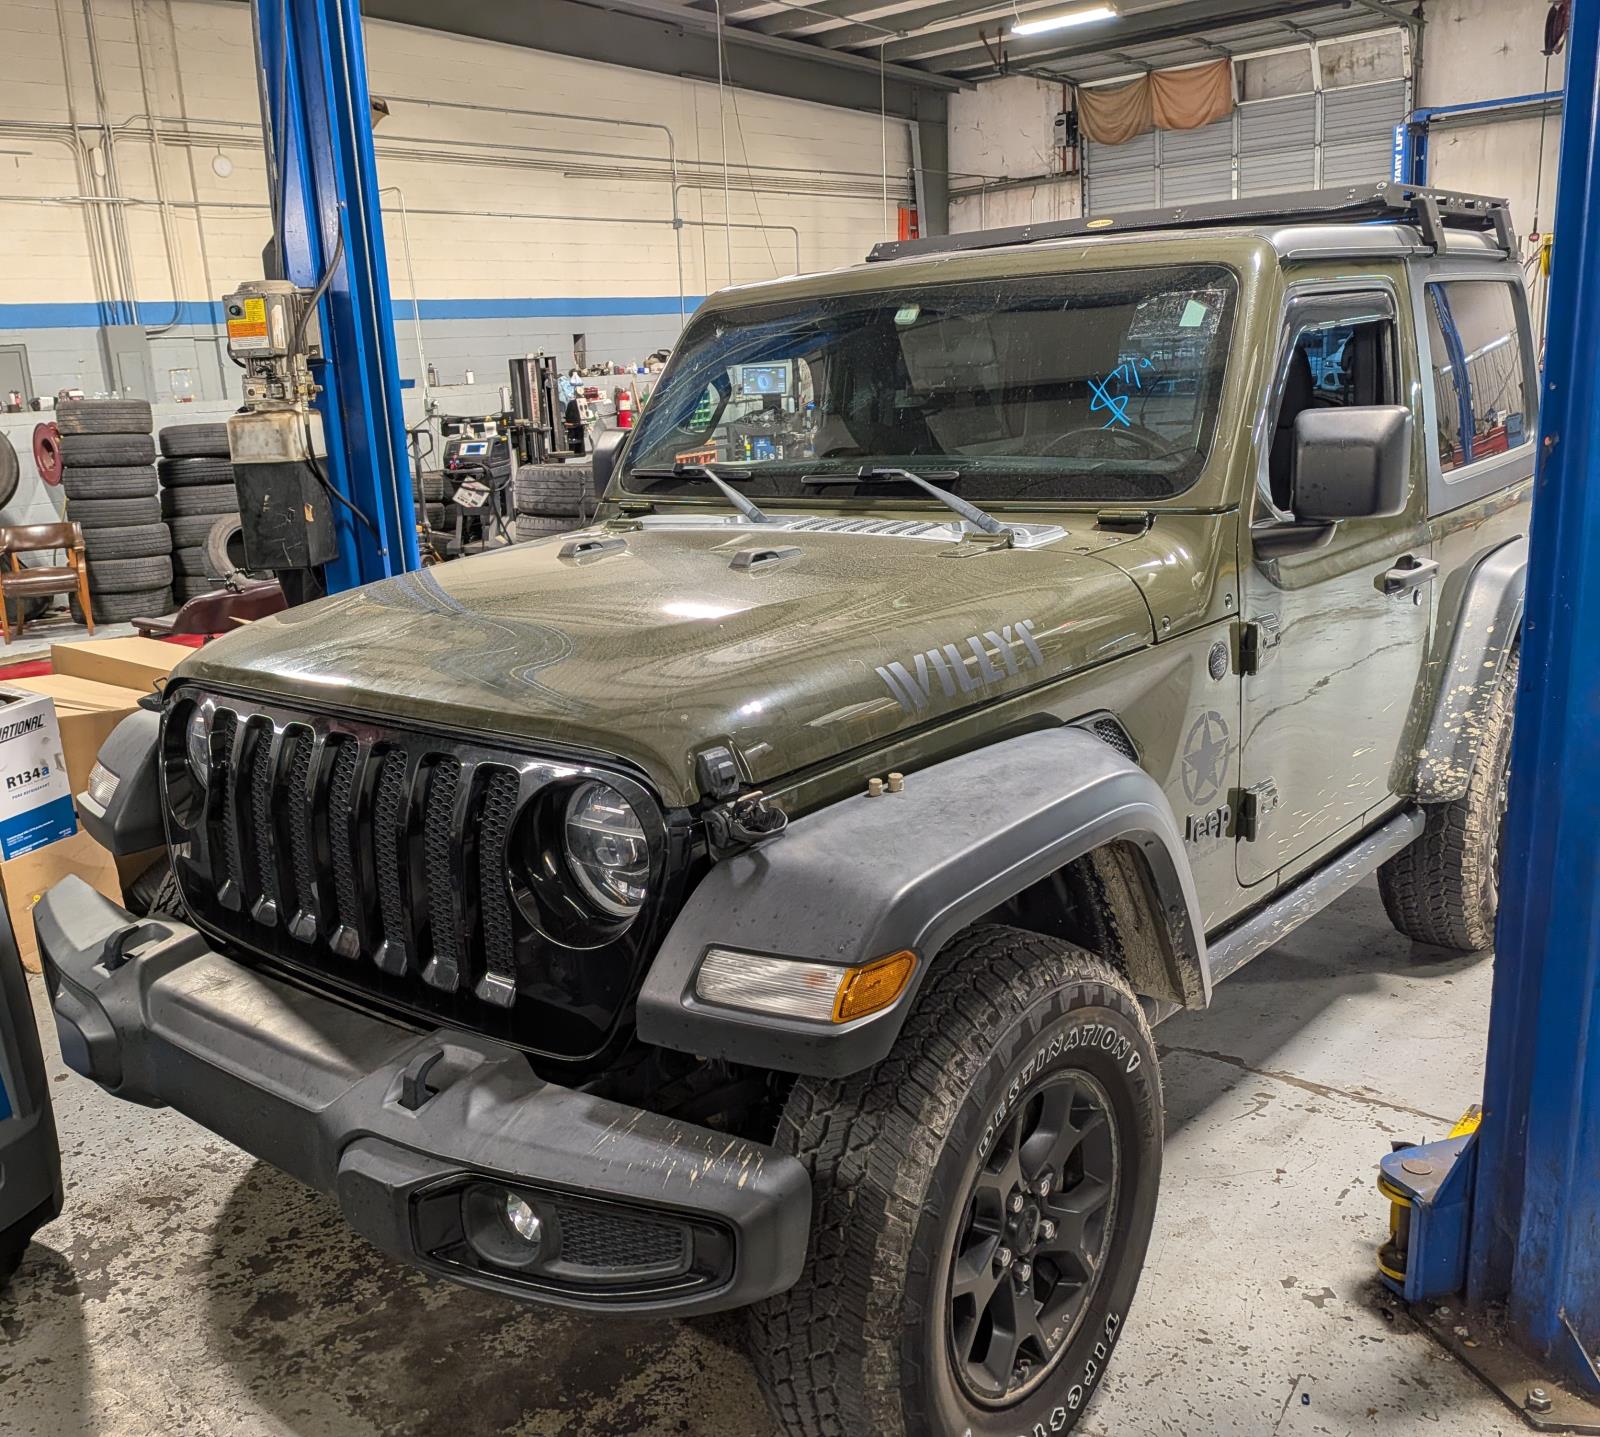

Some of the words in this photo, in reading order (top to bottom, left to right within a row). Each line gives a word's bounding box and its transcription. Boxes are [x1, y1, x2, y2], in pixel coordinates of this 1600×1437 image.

[1395, 127, 1403, 151] LIFT
[874, 619, 1044, 713] WILLYS
[6, 766, 50, 789] R134a
[1185, 804, 1232, 843] Jeep
[979, 1024, 1131, 1157] DESTINATION
